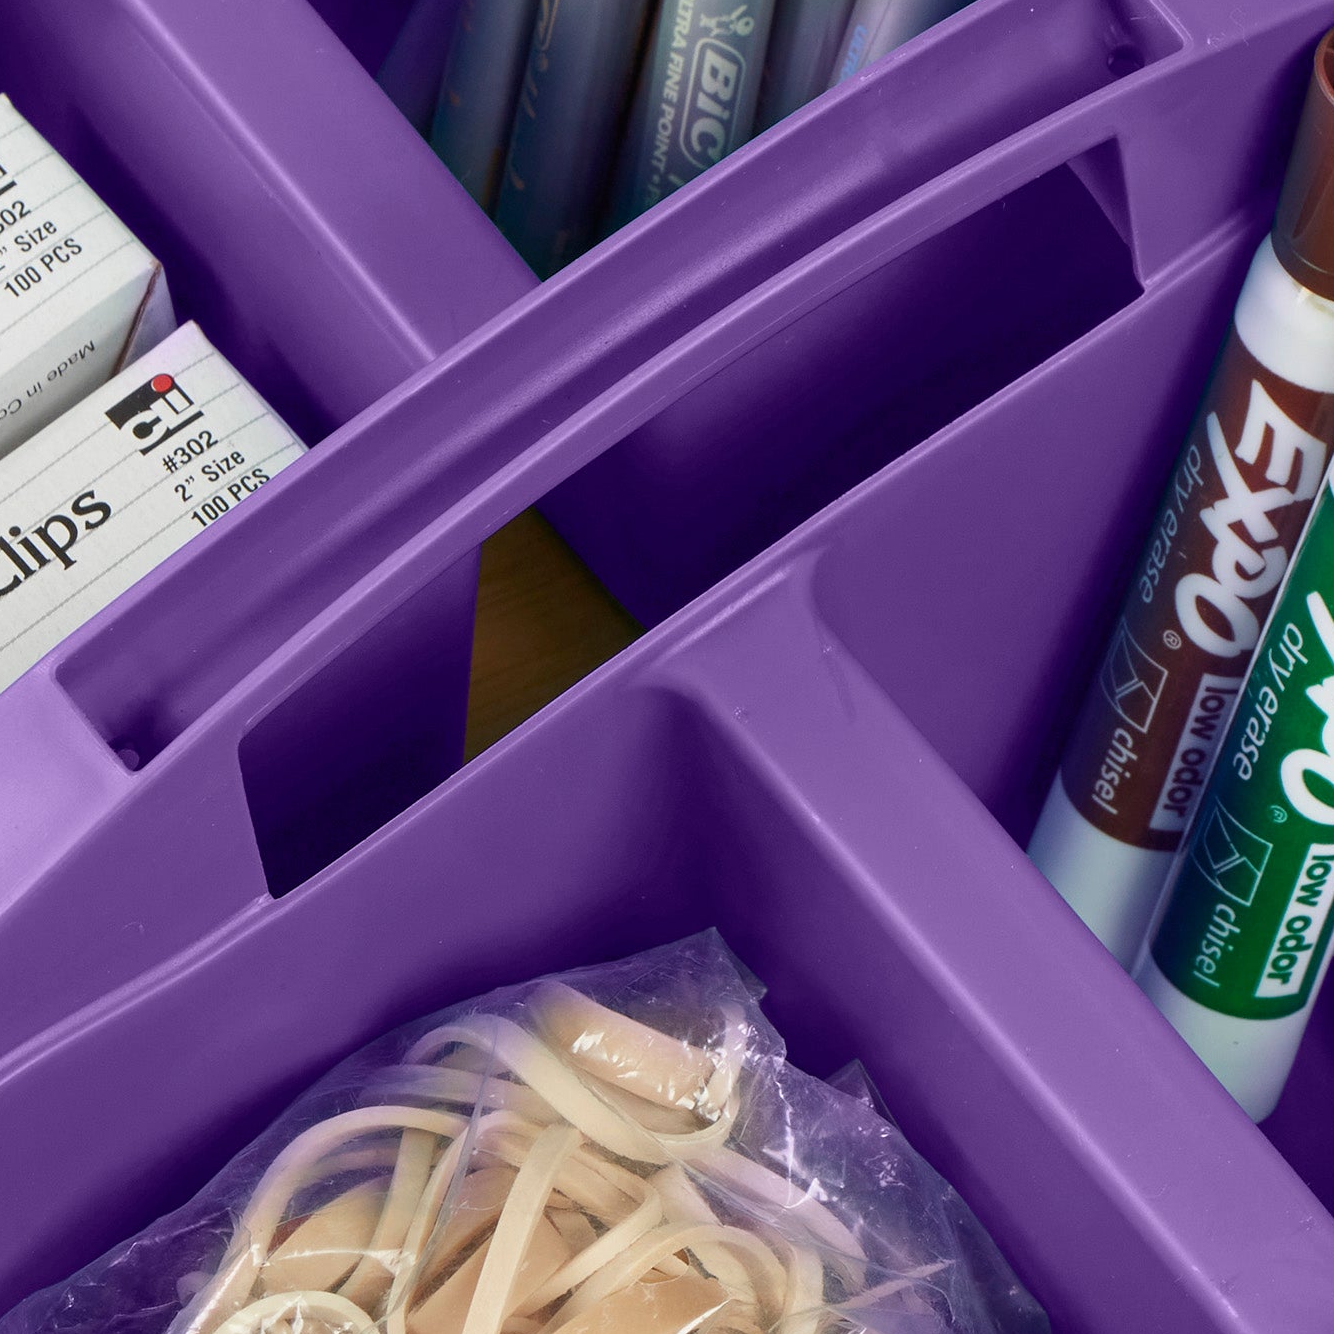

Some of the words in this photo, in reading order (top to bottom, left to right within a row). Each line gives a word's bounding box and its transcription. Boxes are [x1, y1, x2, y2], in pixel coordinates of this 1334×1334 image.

[663, 51, 684, 103] FINE
[651, 104, 677, 171] POINT
[4, 266, 42, 298] 100
[40, 237, 83, 273] PCS
[14, 220, 57, 252] Size
[26, 381, 43, 398] in
[47, 340, 96, 382] Made
[162, 430, 219, 474] #302
[201, 451, 245, 483] Size
[1169, 444, 1203, 511] dry
[191, 495, 229, 527] 100
[227, 467, 271, 502] PCS
[1175, 379, 1328, 658] EXPO
[1138, 512, 1178, 604] erase
[1266, 621, 1308, 695] dry
[1188, 677, 1239, 741] low
[1232, 686, 1279, 782] erase
[1091, 727, 1134, 816] chisel
[1162, 750, 1205, 818] odor
[1192, 904, 1241, 988] chisel
[1265, 915, 1314, 986] odor
